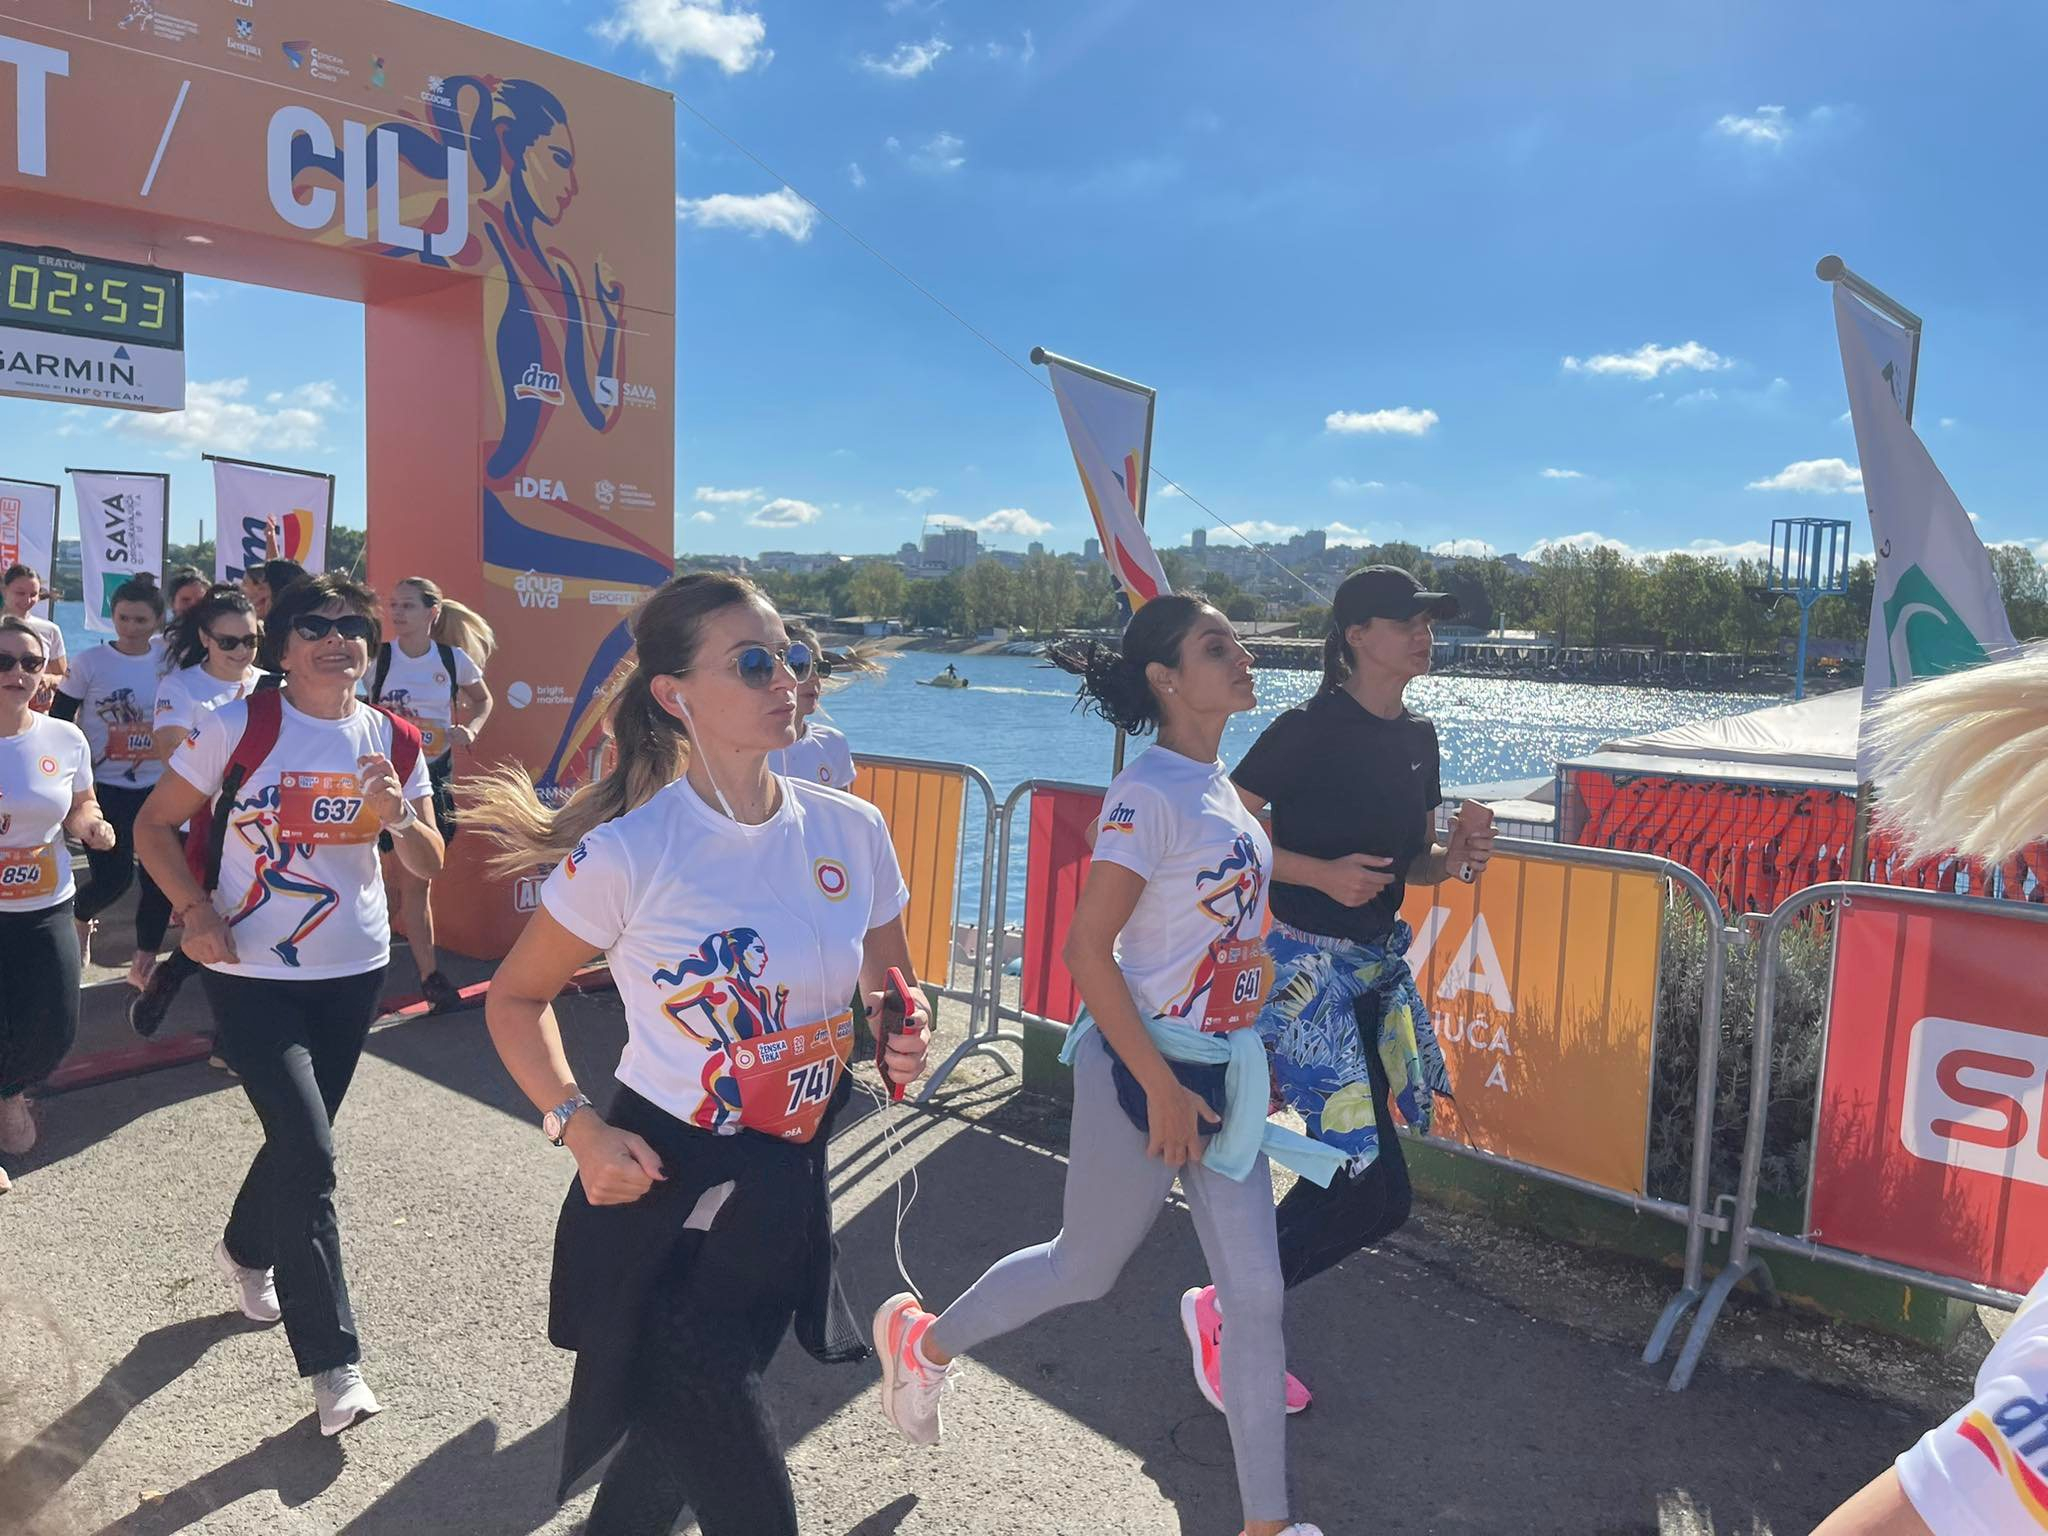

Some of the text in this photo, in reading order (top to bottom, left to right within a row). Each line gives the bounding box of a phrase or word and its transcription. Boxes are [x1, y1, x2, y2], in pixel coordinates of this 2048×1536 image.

[267, 105, 468, 257] CILJ
[38, 255, 86, 271] ERATON
[0, 351, 134, 387] ARMIN
[523, 364, 559, 391] dm
[64, 386, 144, 402] INFOTEAM
[622, 382, 657, 400] SAVA
[102, 493, 128, 563] SAVA
[516, 591, 559, 609] viva
[536, 685, 565, 699] bright
[536, 696, 574, 705] marbles
[312, 796, 364, 824] 637
[1109, 803, 1136, 823] dm
[2, 864, 41, 885] 854
[1232, 966, 1262, 1004] 641
[761, 1050, 781, 1063] TRKA
[784, 1055, 837, 1116] 741
